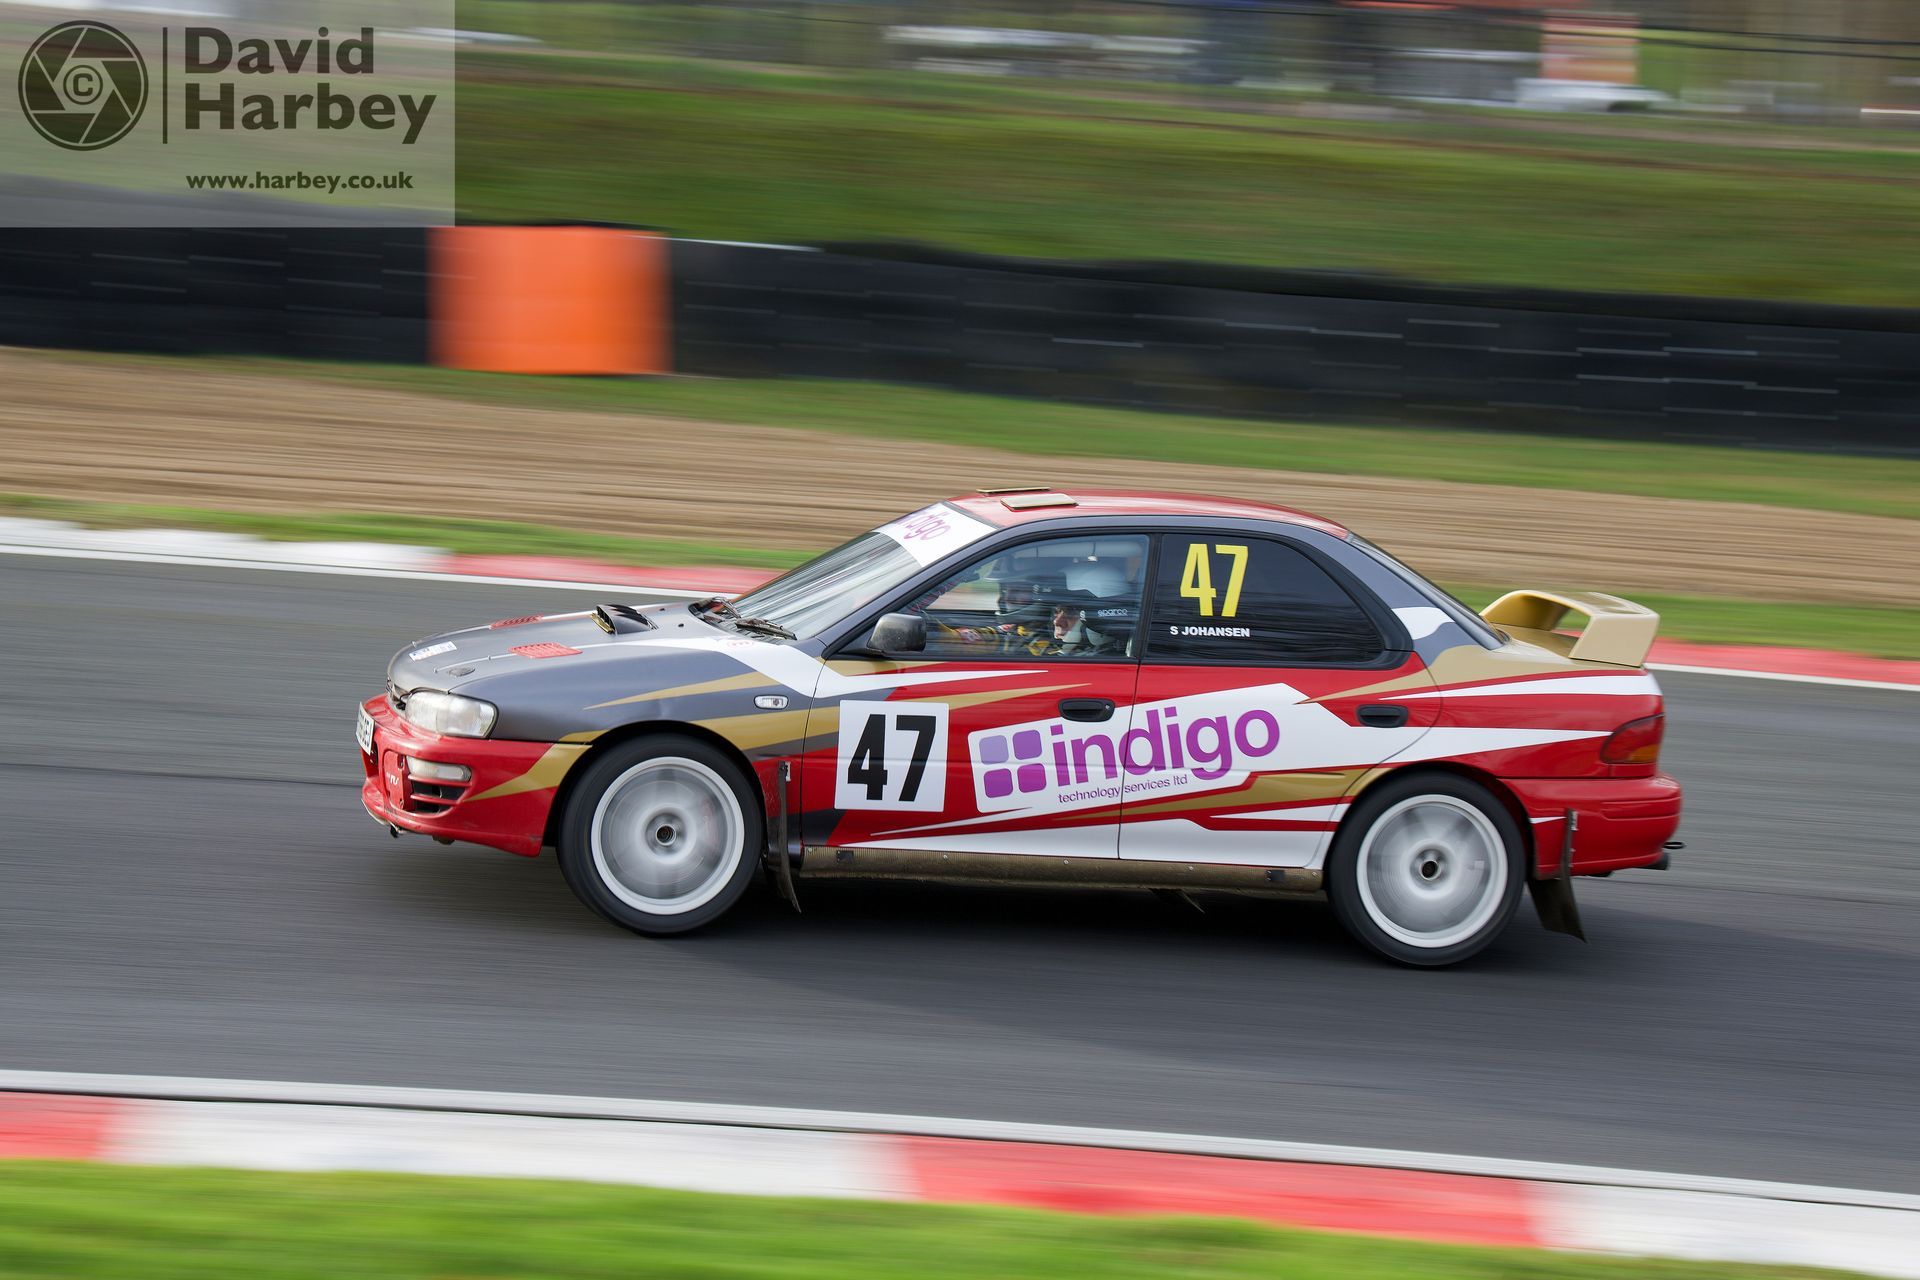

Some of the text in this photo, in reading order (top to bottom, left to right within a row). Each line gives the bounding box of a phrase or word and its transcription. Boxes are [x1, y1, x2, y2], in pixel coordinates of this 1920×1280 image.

[1179, 543, 1249, 618] 47
[1169, 625, 1251, 638] S JOHANSEN
[847, 713, 937, 802] 47
[1050, 706, 1280, 788] indigo
[1058, 774, 1188, 803] technology services ltd
